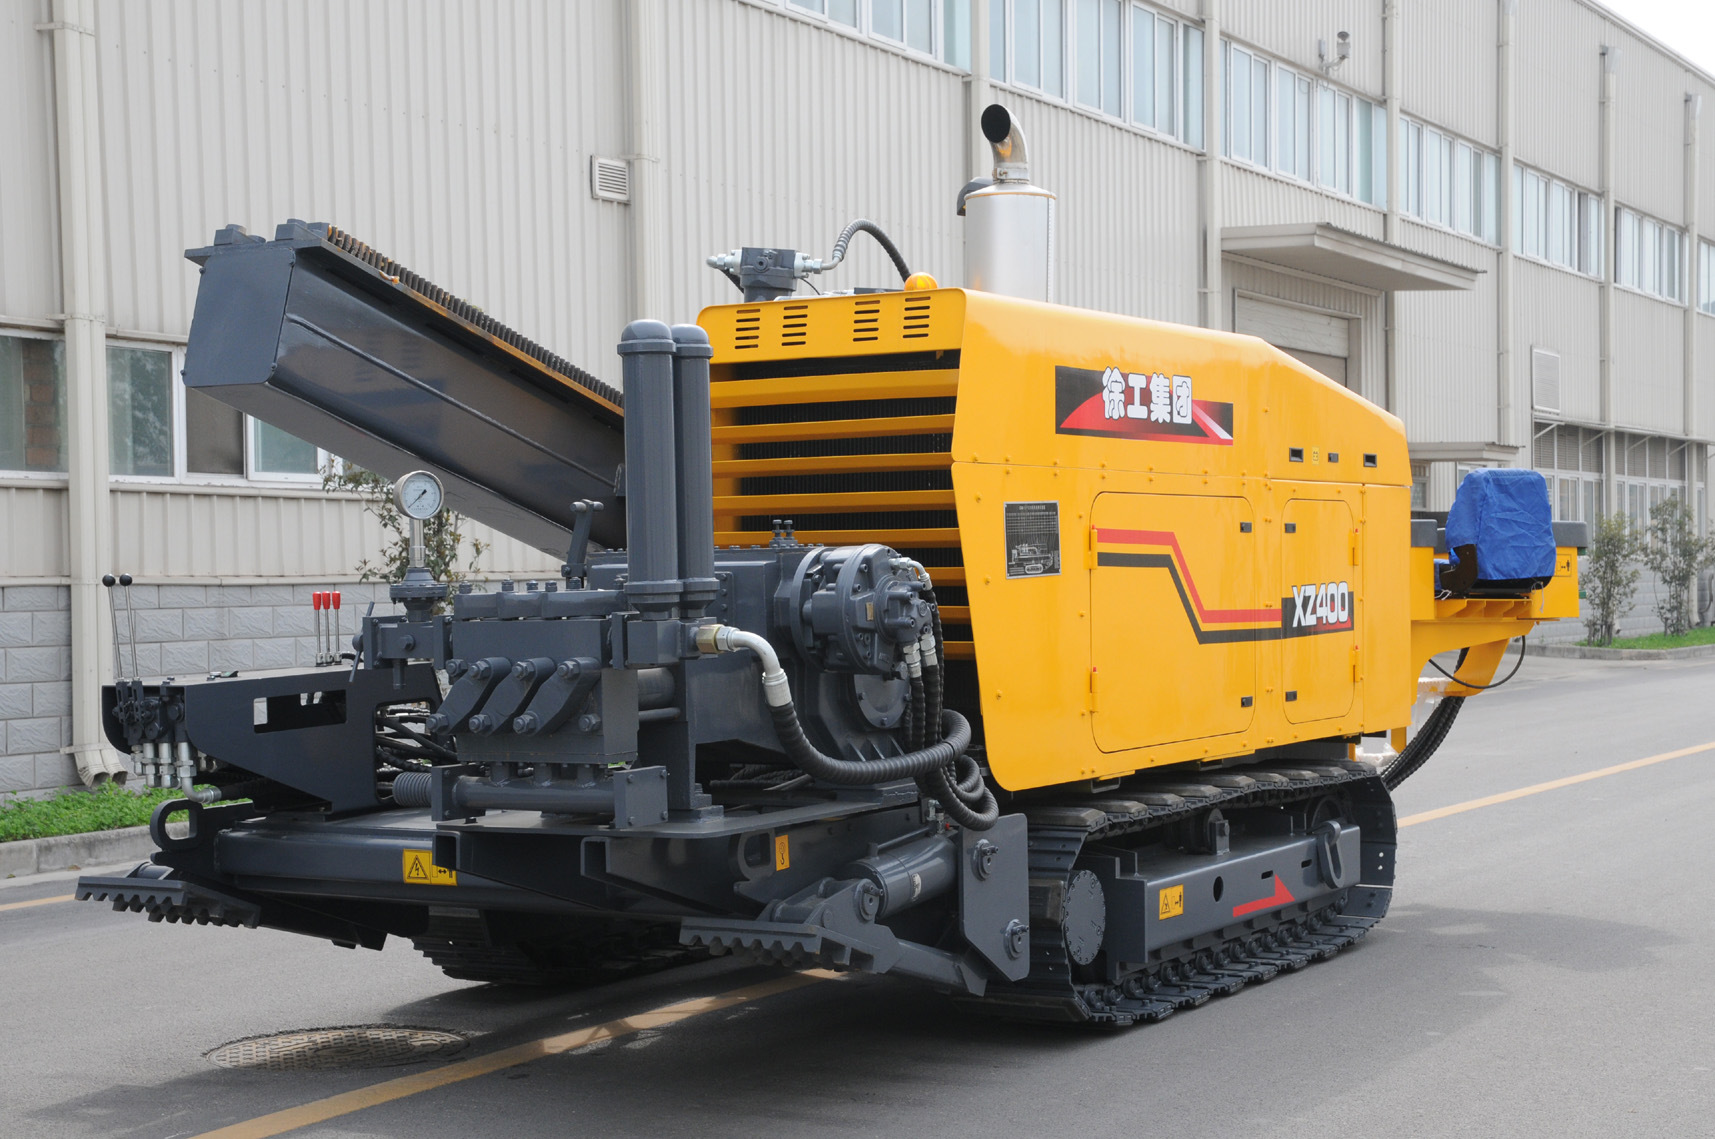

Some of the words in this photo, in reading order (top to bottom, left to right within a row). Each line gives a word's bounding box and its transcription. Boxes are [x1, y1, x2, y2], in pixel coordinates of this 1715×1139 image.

[1102, 366, 1193, 425] 徐工集团
[1292, 581, 1349, 628] XZ400
